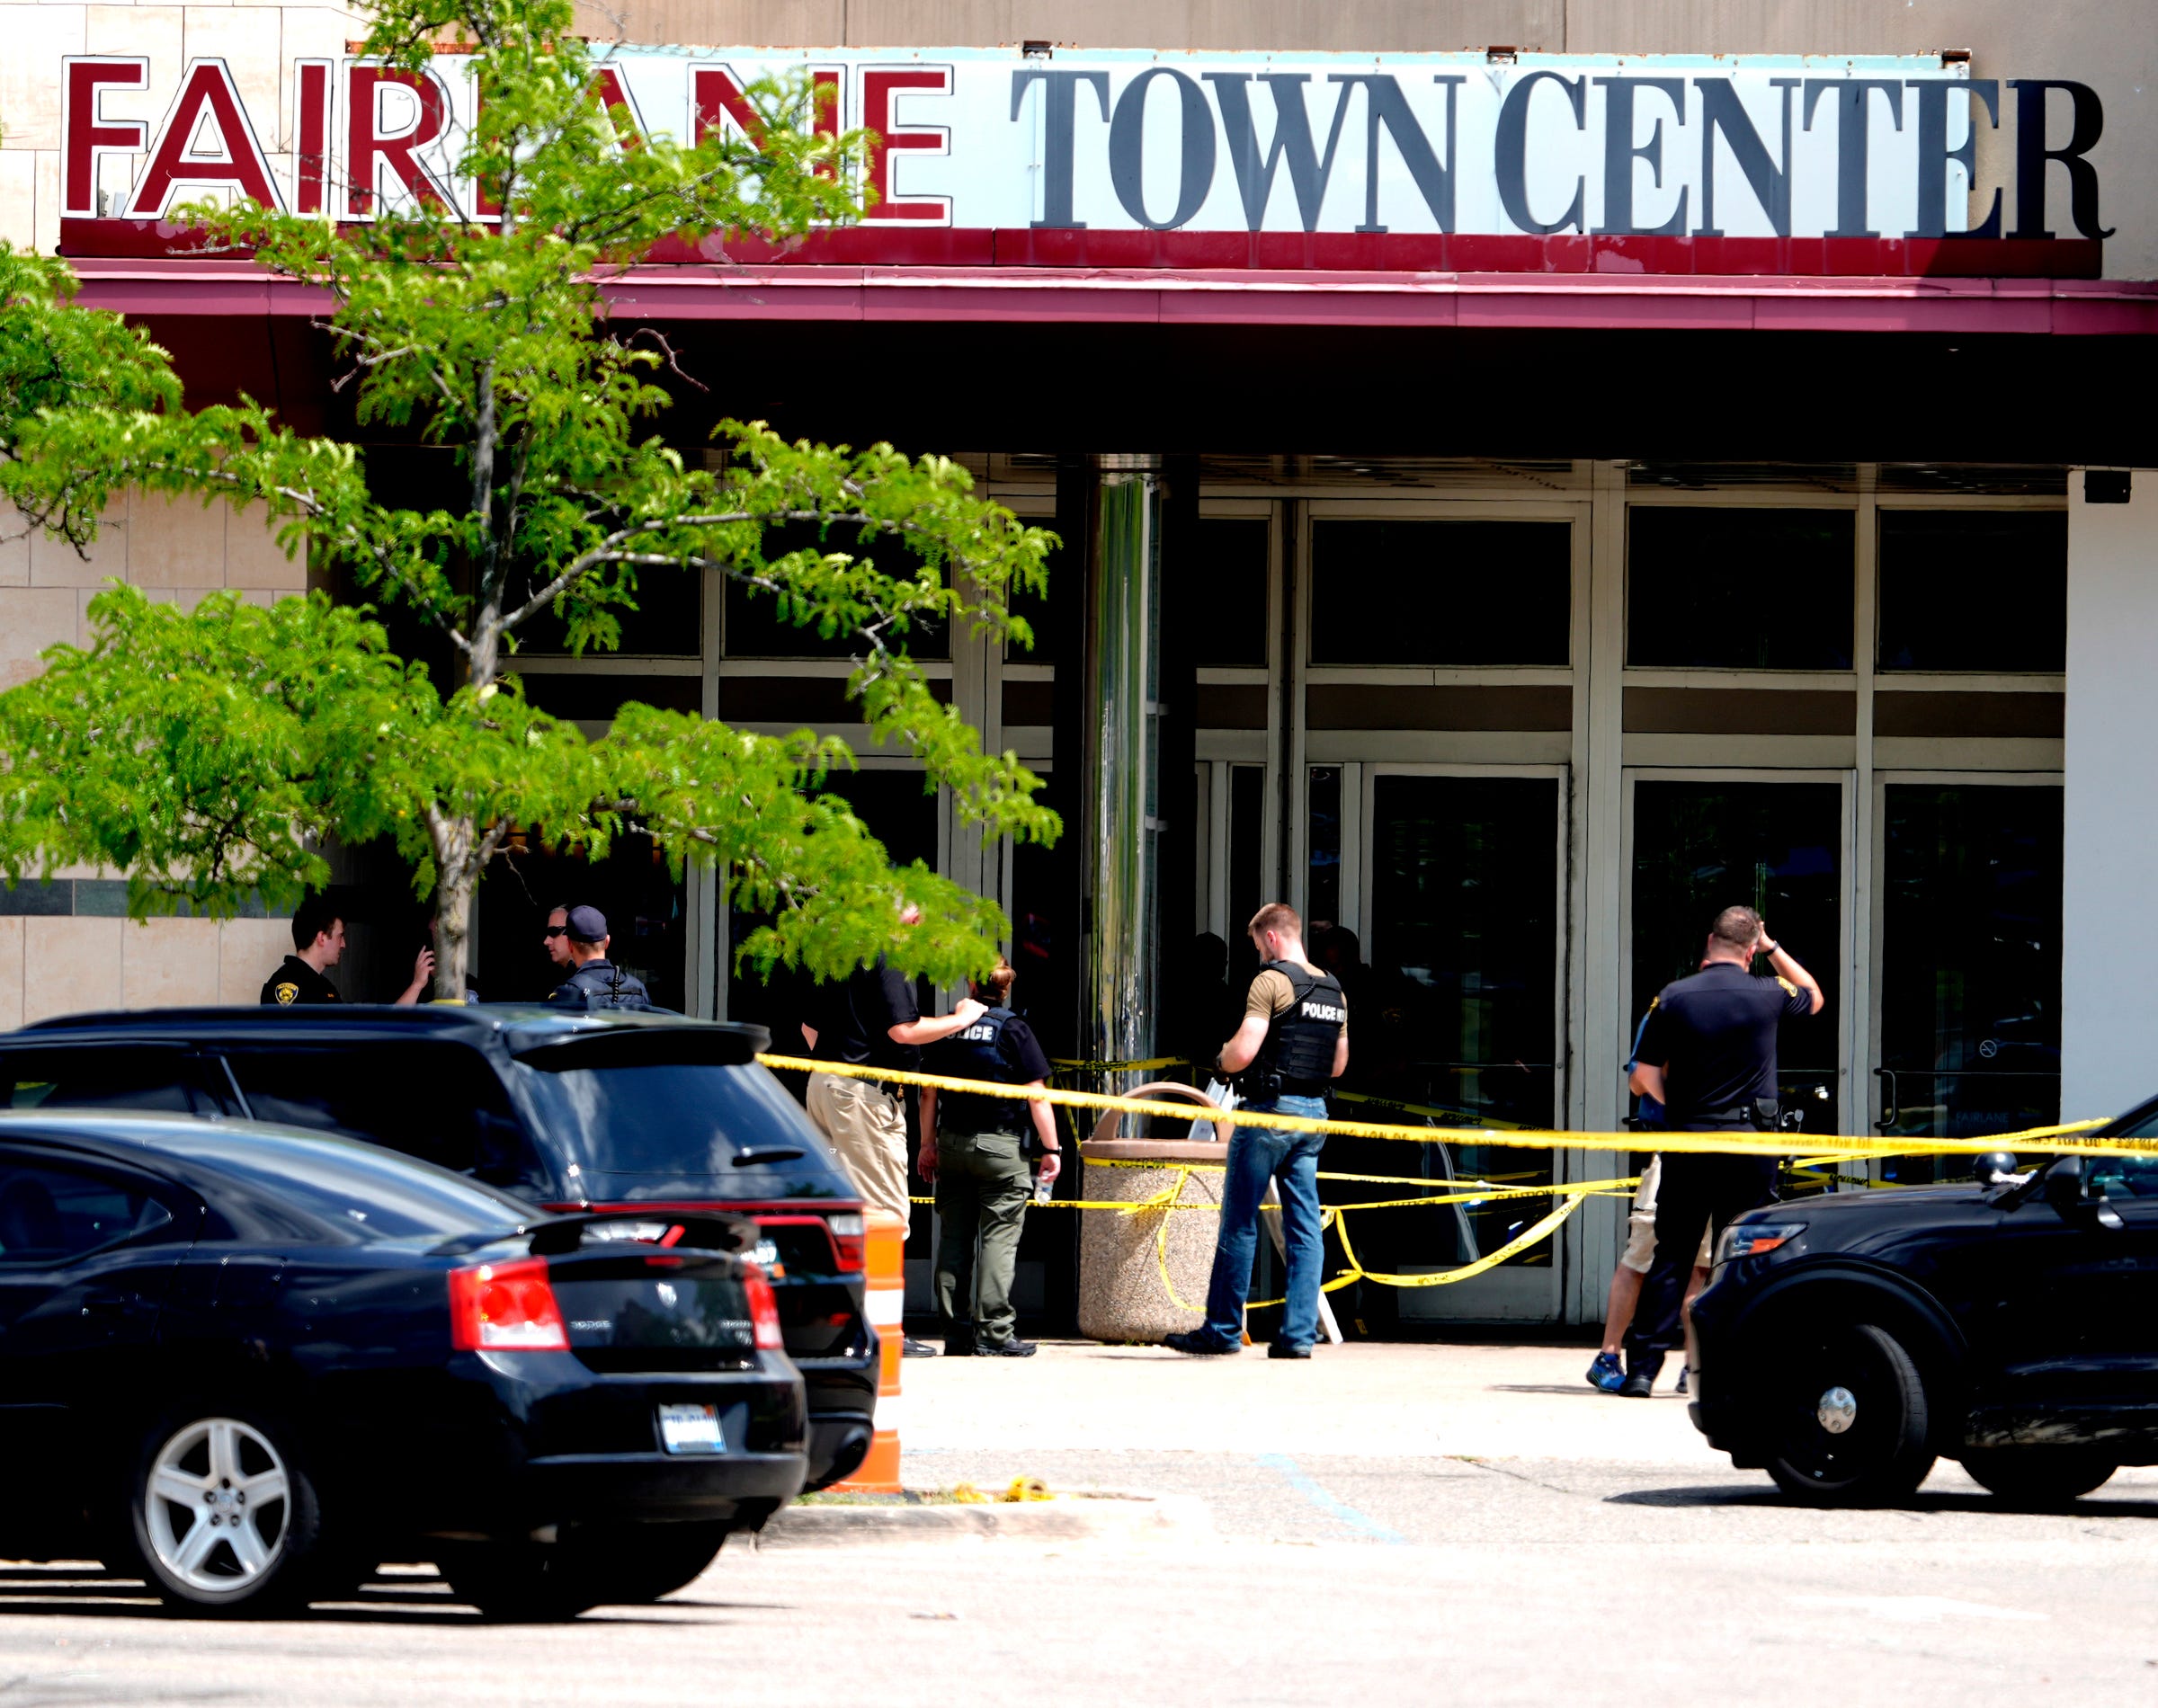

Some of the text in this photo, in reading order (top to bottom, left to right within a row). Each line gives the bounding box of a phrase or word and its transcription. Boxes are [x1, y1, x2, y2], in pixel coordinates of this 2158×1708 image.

[1011, 67, 1467, 233] TOWN
[1494, 70, 2117, 239] CENTER
[1302, 1001, 1336, 1021] POLICE
